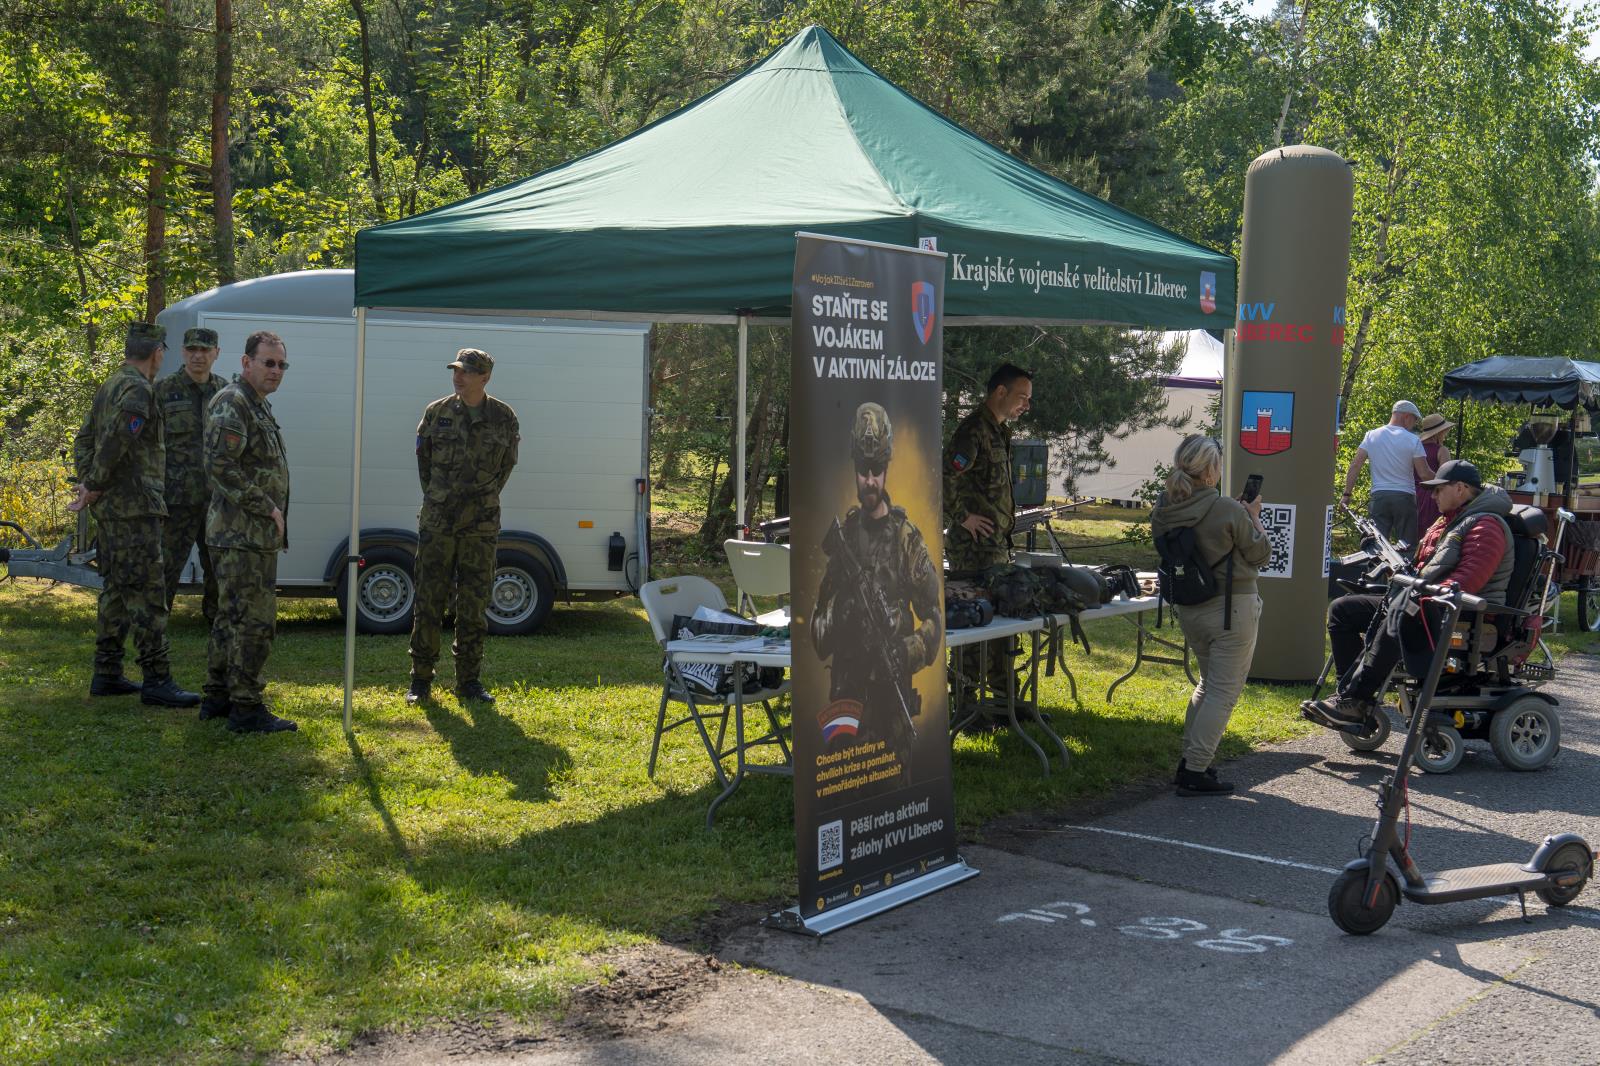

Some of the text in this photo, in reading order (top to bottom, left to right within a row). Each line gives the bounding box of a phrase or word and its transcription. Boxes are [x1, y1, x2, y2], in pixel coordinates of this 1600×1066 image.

[951, 253, 1188, 299] Krajské vojenské velitelství Liberec
[812, 292, 889, 322] STAŇTE SE
[1238, 303, 1275, 321] KVV
[812, 323, 884, 350] VOJÁKEM
[812, 354, 937, 381] V AKTIVNÍ ZÁLOZE
[816, 740, 886, 766] Chcete být hrdiny ve
[843, 761, 860, 775] krize
[861, 761, 866, 769] a
[867, 752, 896, 771] pomáhat
[816, 788, 823, 798] v
[850, 797, 930, 837] Pěší rota aktivní
[850, 819, 944, 861] zálohy KVV Liberec
